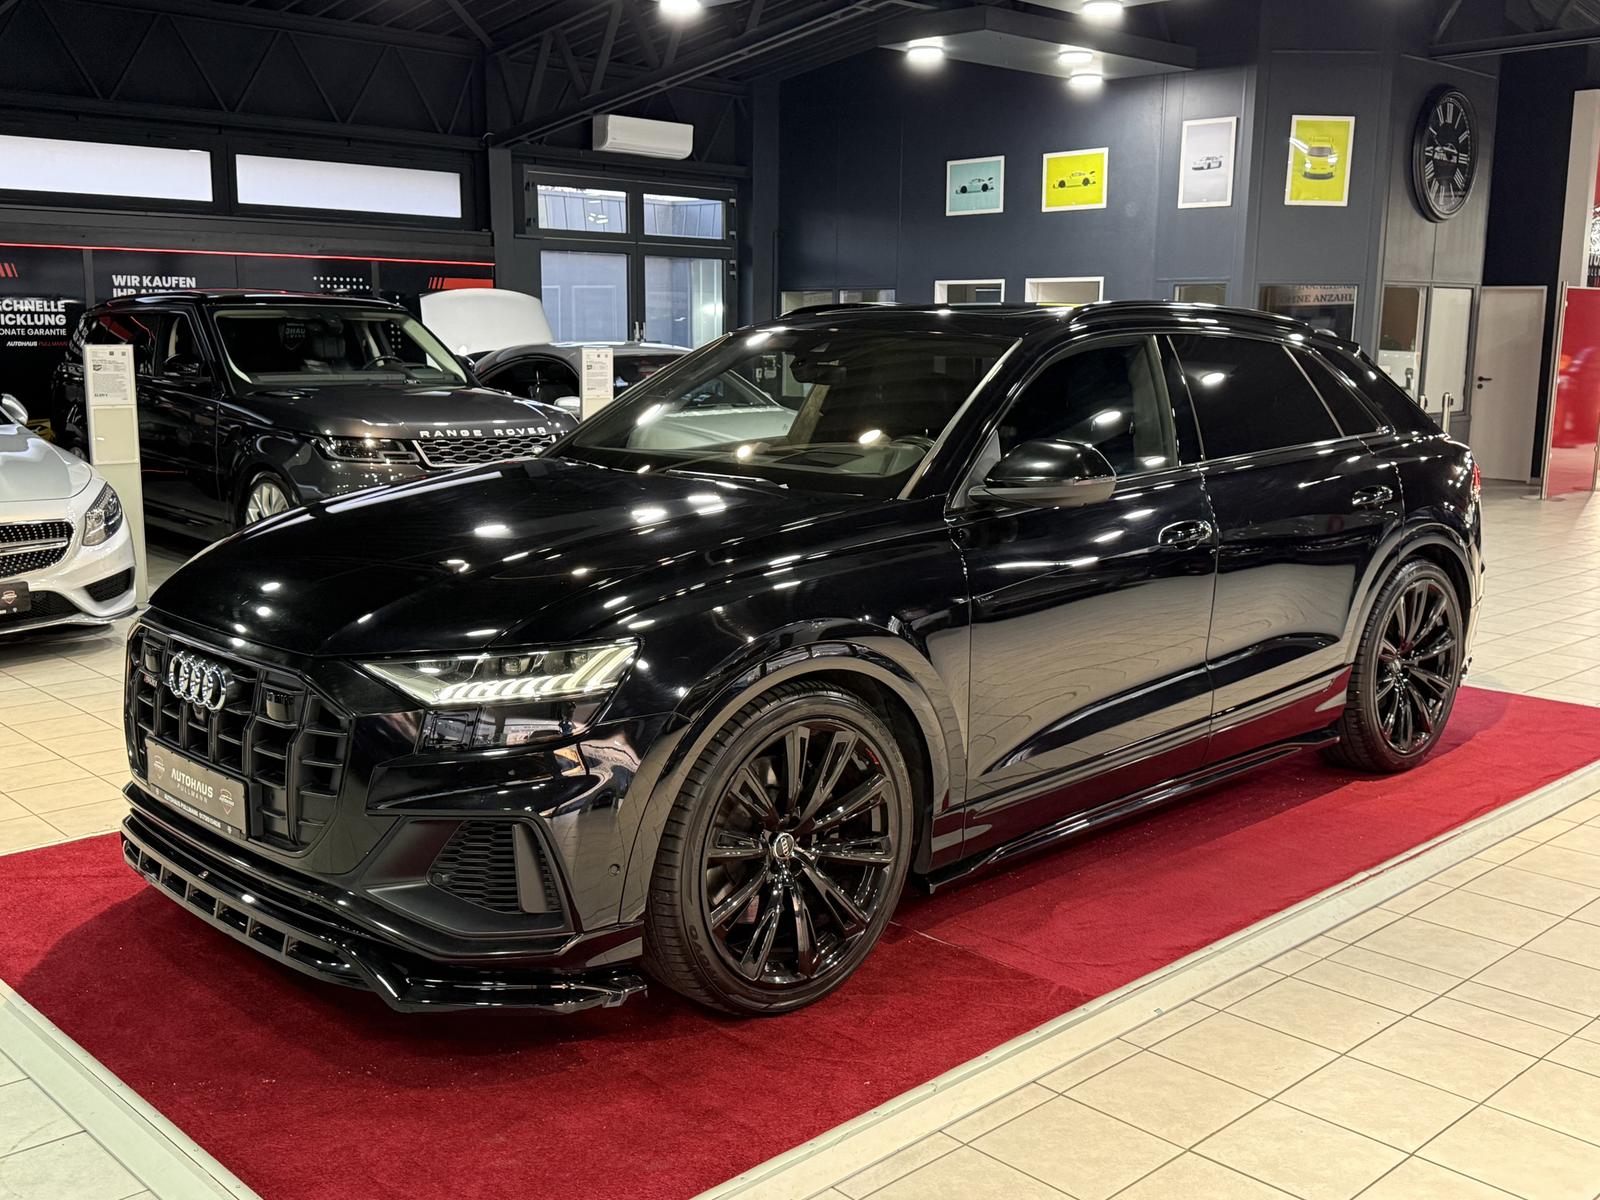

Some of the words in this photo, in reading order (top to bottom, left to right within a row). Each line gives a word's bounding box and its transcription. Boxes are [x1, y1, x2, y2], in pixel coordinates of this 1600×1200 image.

[112, 275, 140, 287] WIR
[142, 276, 196, 288] KAUFEN
[0, 300, 66, 312] CHNELLE
[0, 314, 67, 326] ICKLUNG
[27, 328, 67, 336] GARANTIE
[419, 429, 483, 438] RANGE
[493, 427, 547, 437] ROVER
[171, 768, 214, 798] AUTOHAUS
